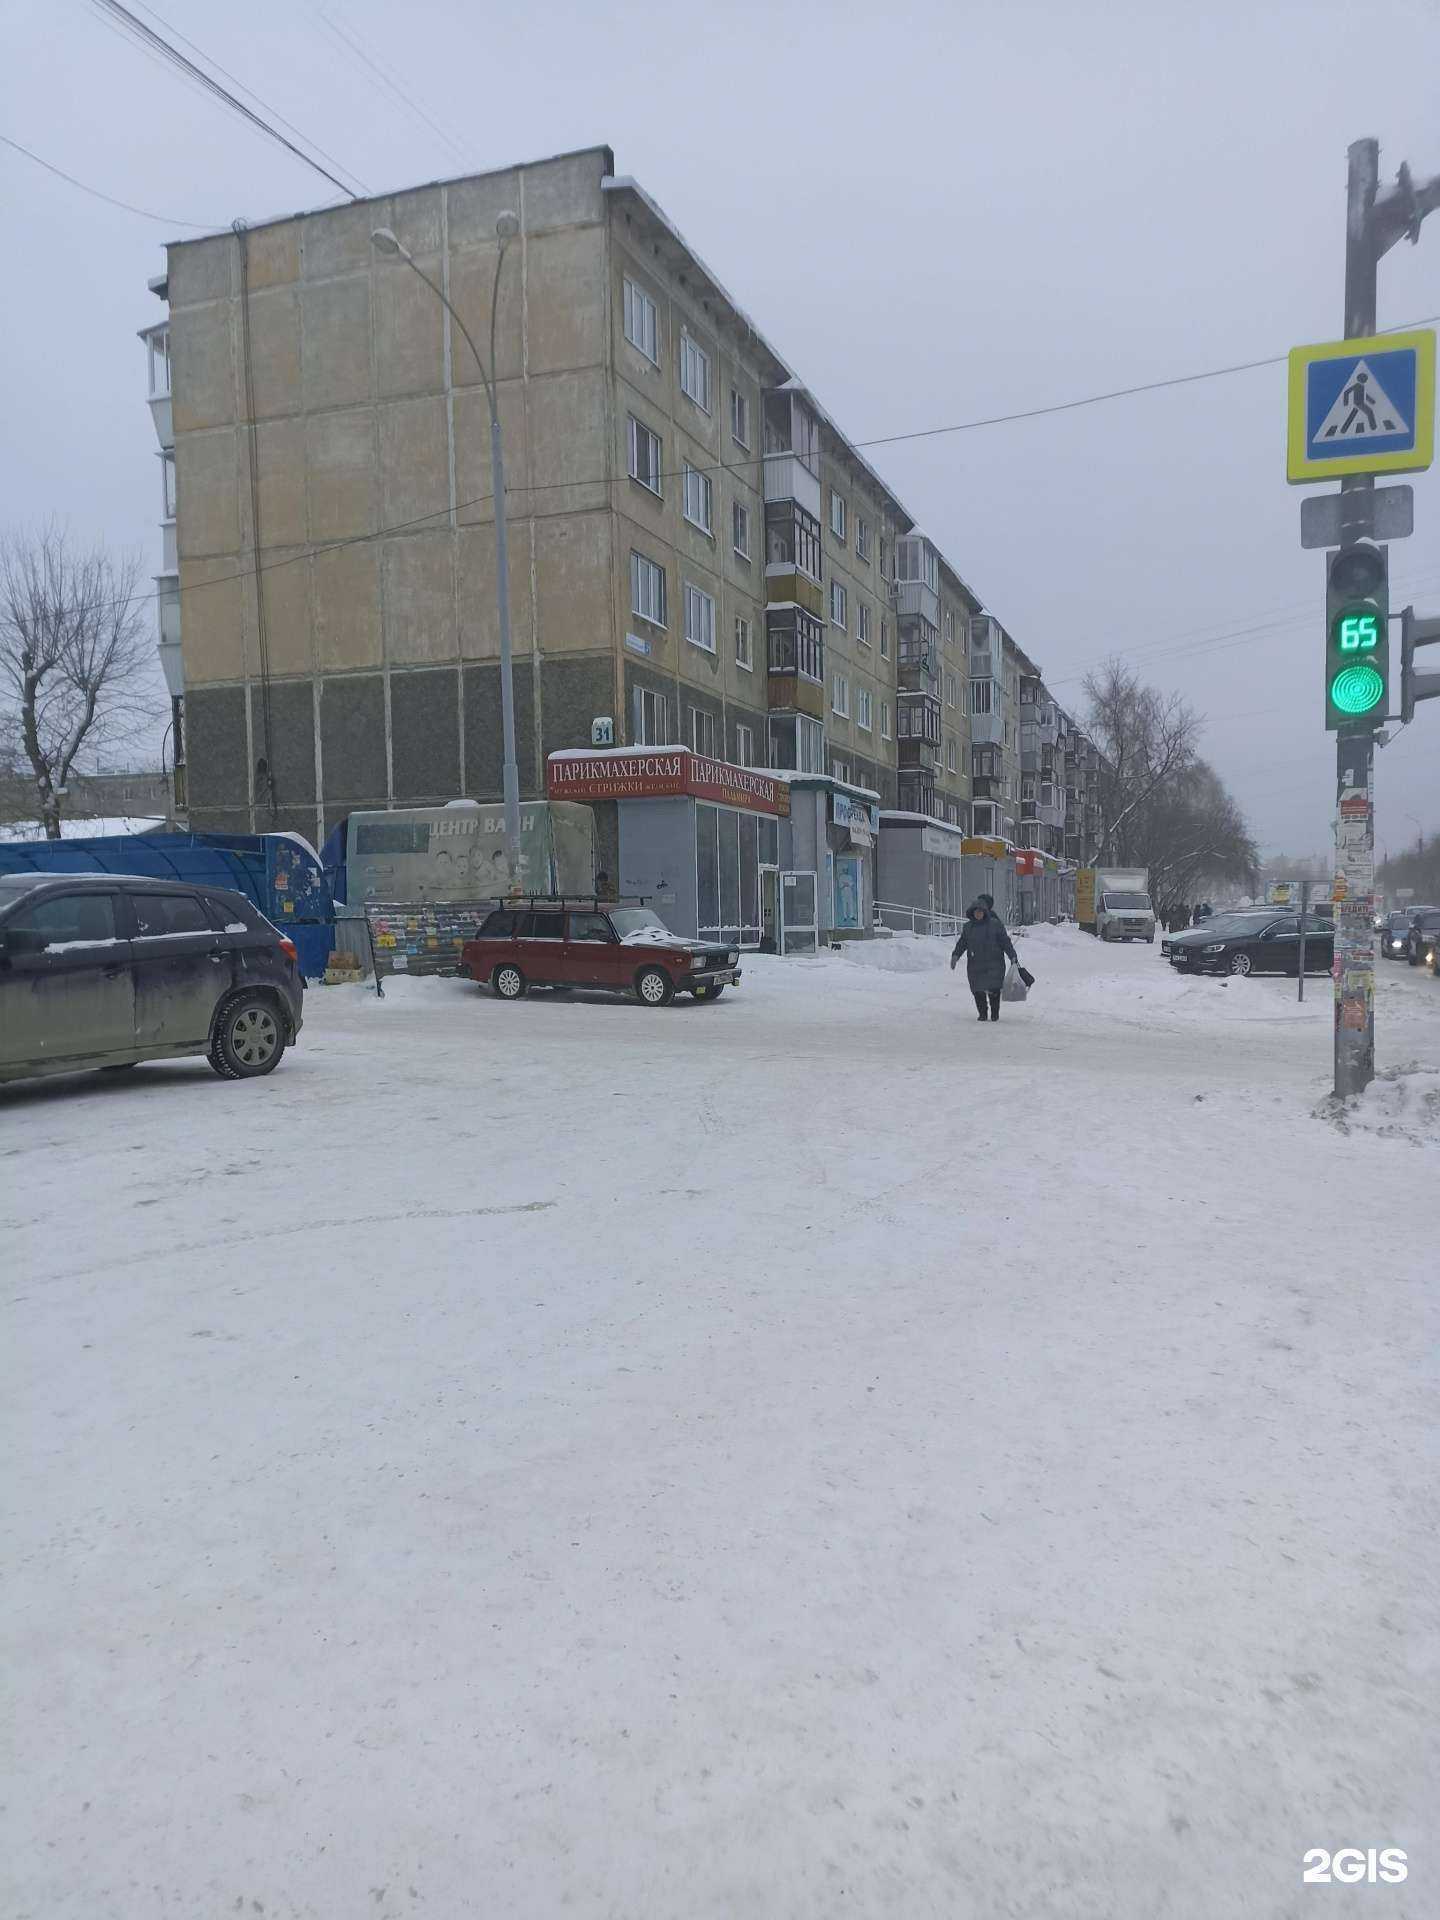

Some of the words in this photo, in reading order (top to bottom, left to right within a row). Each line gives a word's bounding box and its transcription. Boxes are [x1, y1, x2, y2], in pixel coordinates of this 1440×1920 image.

[1340, 617, 1377, 650] 65
[595, 726, 610, 742] 31
[552, 756, 681, 783] ПАРИКМАХЕРСКАЯ
[690, 758, 774, 803] ПАРИКМАХЕРСКАЯ
[589, 781, 643, 793] СТРИЖКИ
[429, 818, 479, 839] ЦЕНТР
